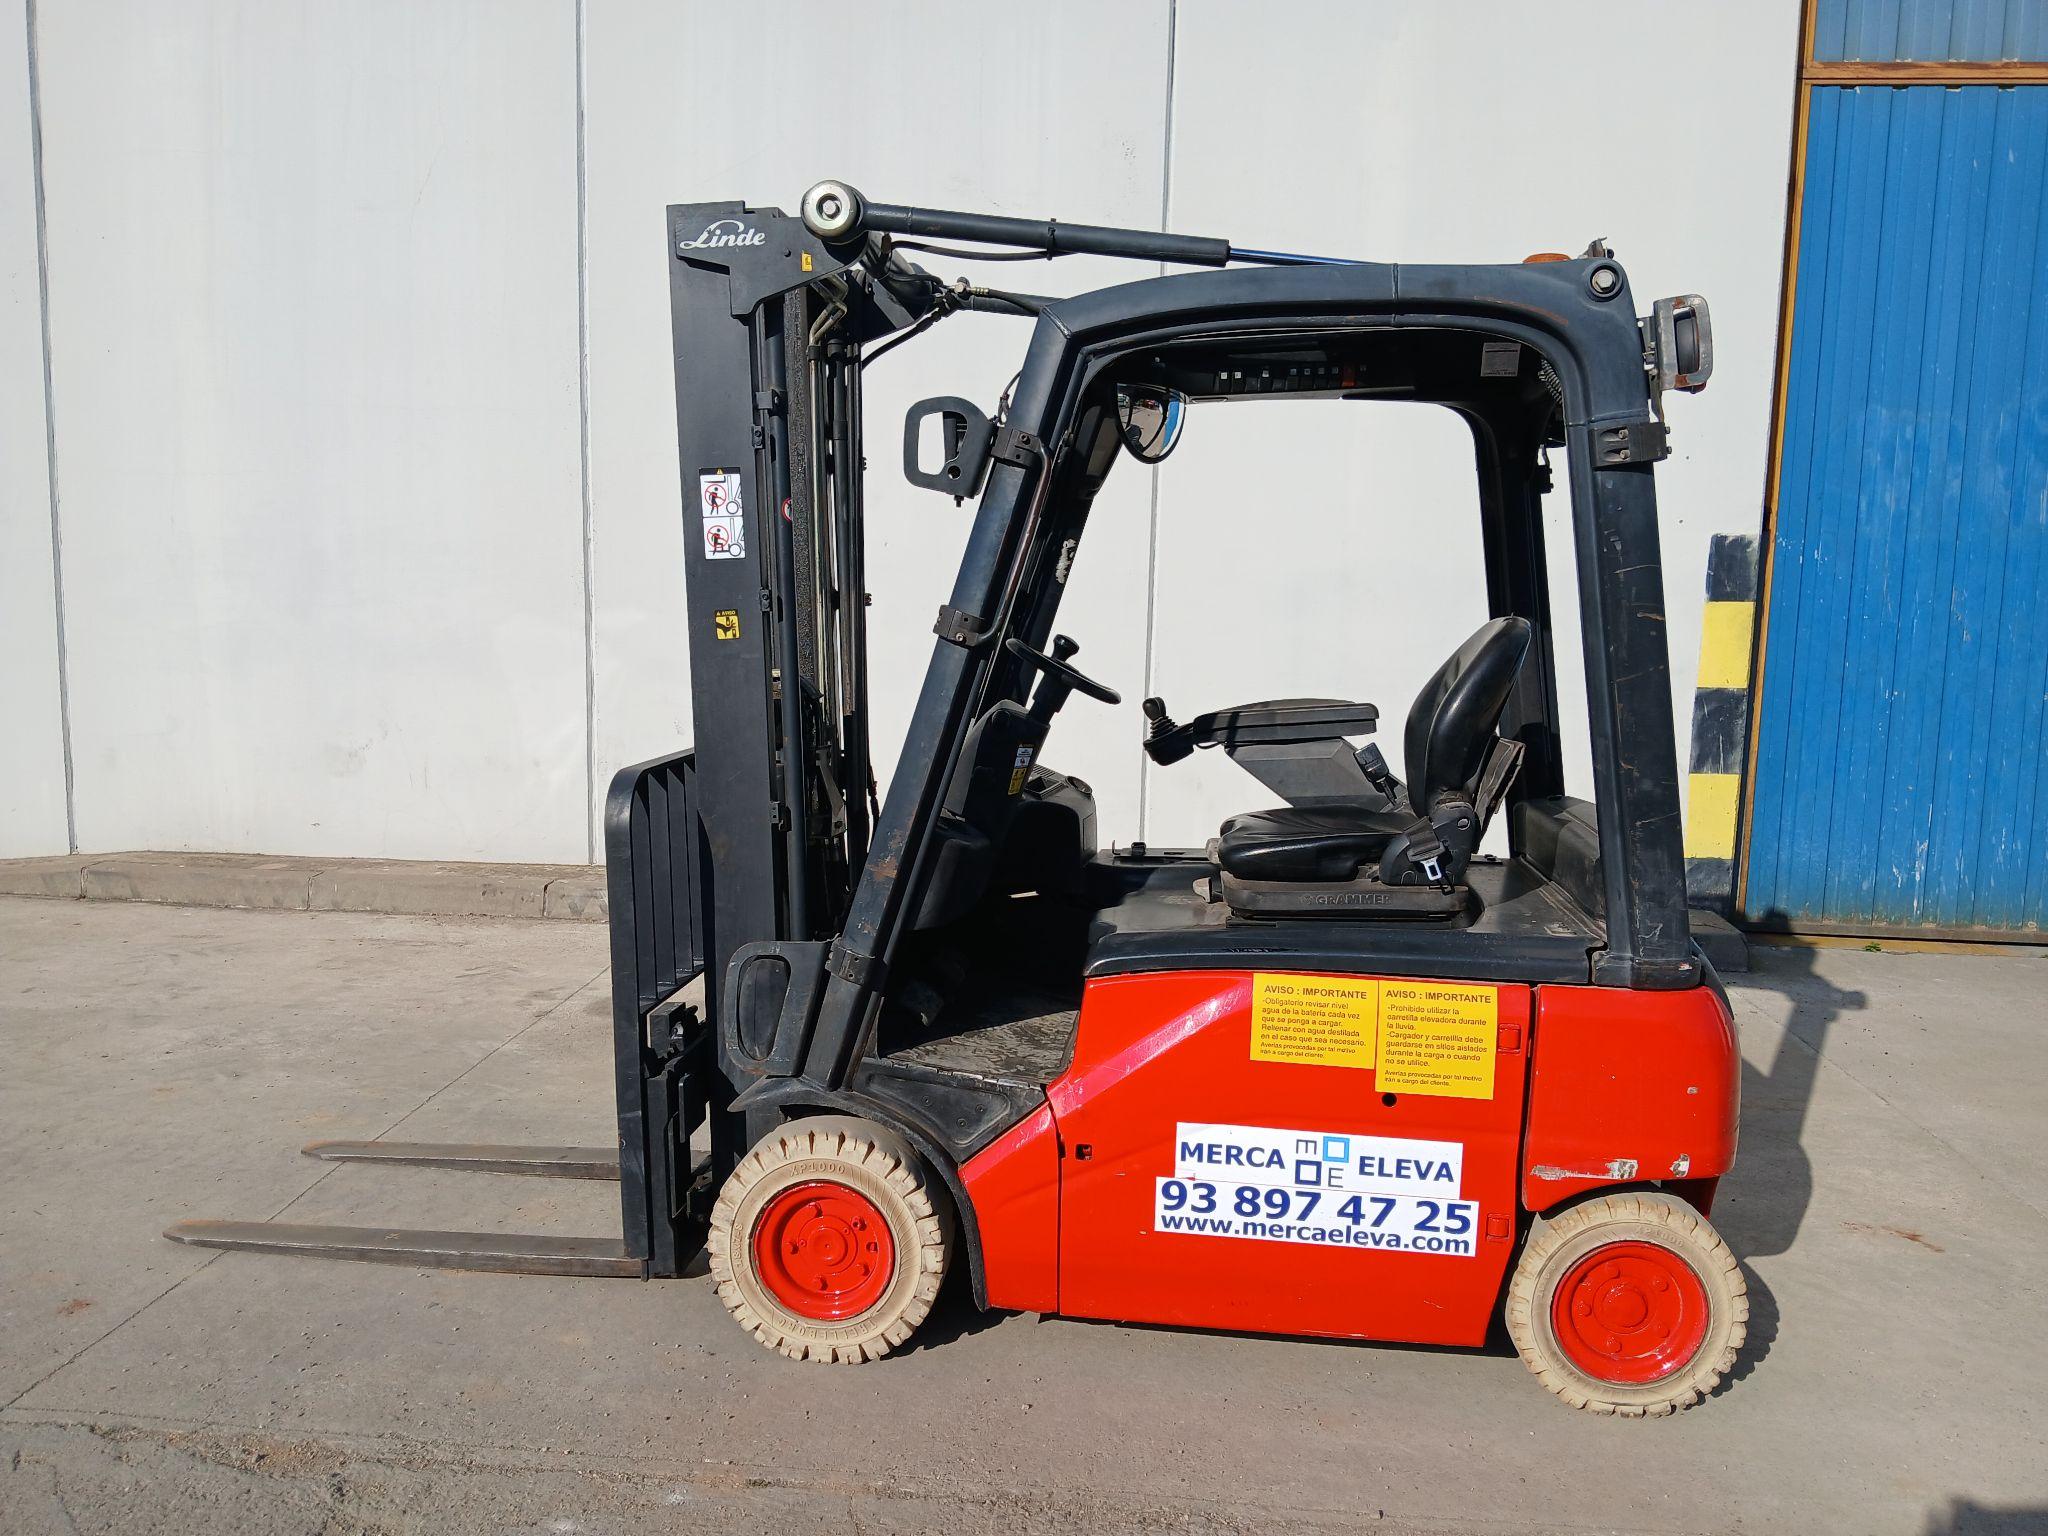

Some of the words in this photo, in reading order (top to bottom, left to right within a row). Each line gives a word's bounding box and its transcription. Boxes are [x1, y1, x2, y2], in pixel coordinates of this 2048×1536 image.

[680, 219, 767, 249] Linde
[1316, 894, 1392, 904] GRAMMER
[1264, 985, 1294, 994] AVISO
[1303, 988, 1367, 999] IMPORTANTE
[1386, 990, 1416, 998] AVISO
[1425, 992, 1491, 1003] IMPORTANTE
[1427, 1006, 1451, 1014] utilizar
[1420, 1016, 1456, 1024] elevadora
[1180, 1141, 1286, 1169] MERCA
[791, 1162, 845, 1176] XP1000
[1358, 1156, 1454, 1182] ELEVA
[1161, 1180, 1217, 1214] 93
[1233, 1186, 1321, 1221] 897
[1337, 1195, 1397, 1228] 47
[1413, 1201, 1472, 1234] 25
[1161, 1214, 1470, 1254] www.mercaeleva.com
